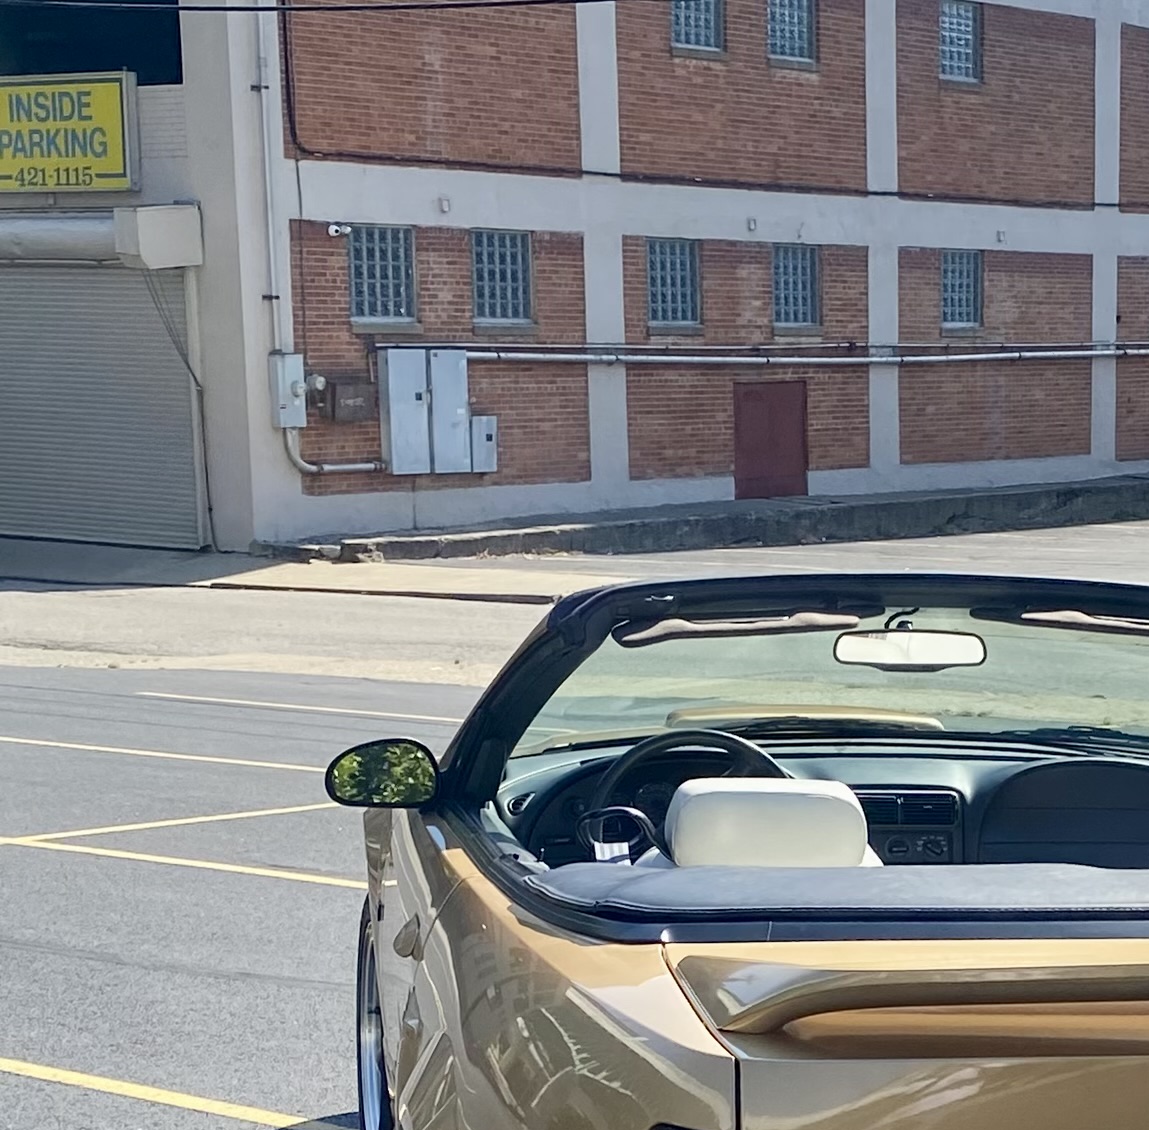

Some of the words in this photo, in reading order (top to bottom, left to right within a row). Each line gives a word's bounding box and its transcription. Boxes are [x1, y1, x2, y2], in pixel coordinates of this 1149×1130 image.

[8, 91, 93, 122] INSIDE
[0, 127, 108, 159] PARKING
[14, 166, 93, 187] 421-1115
